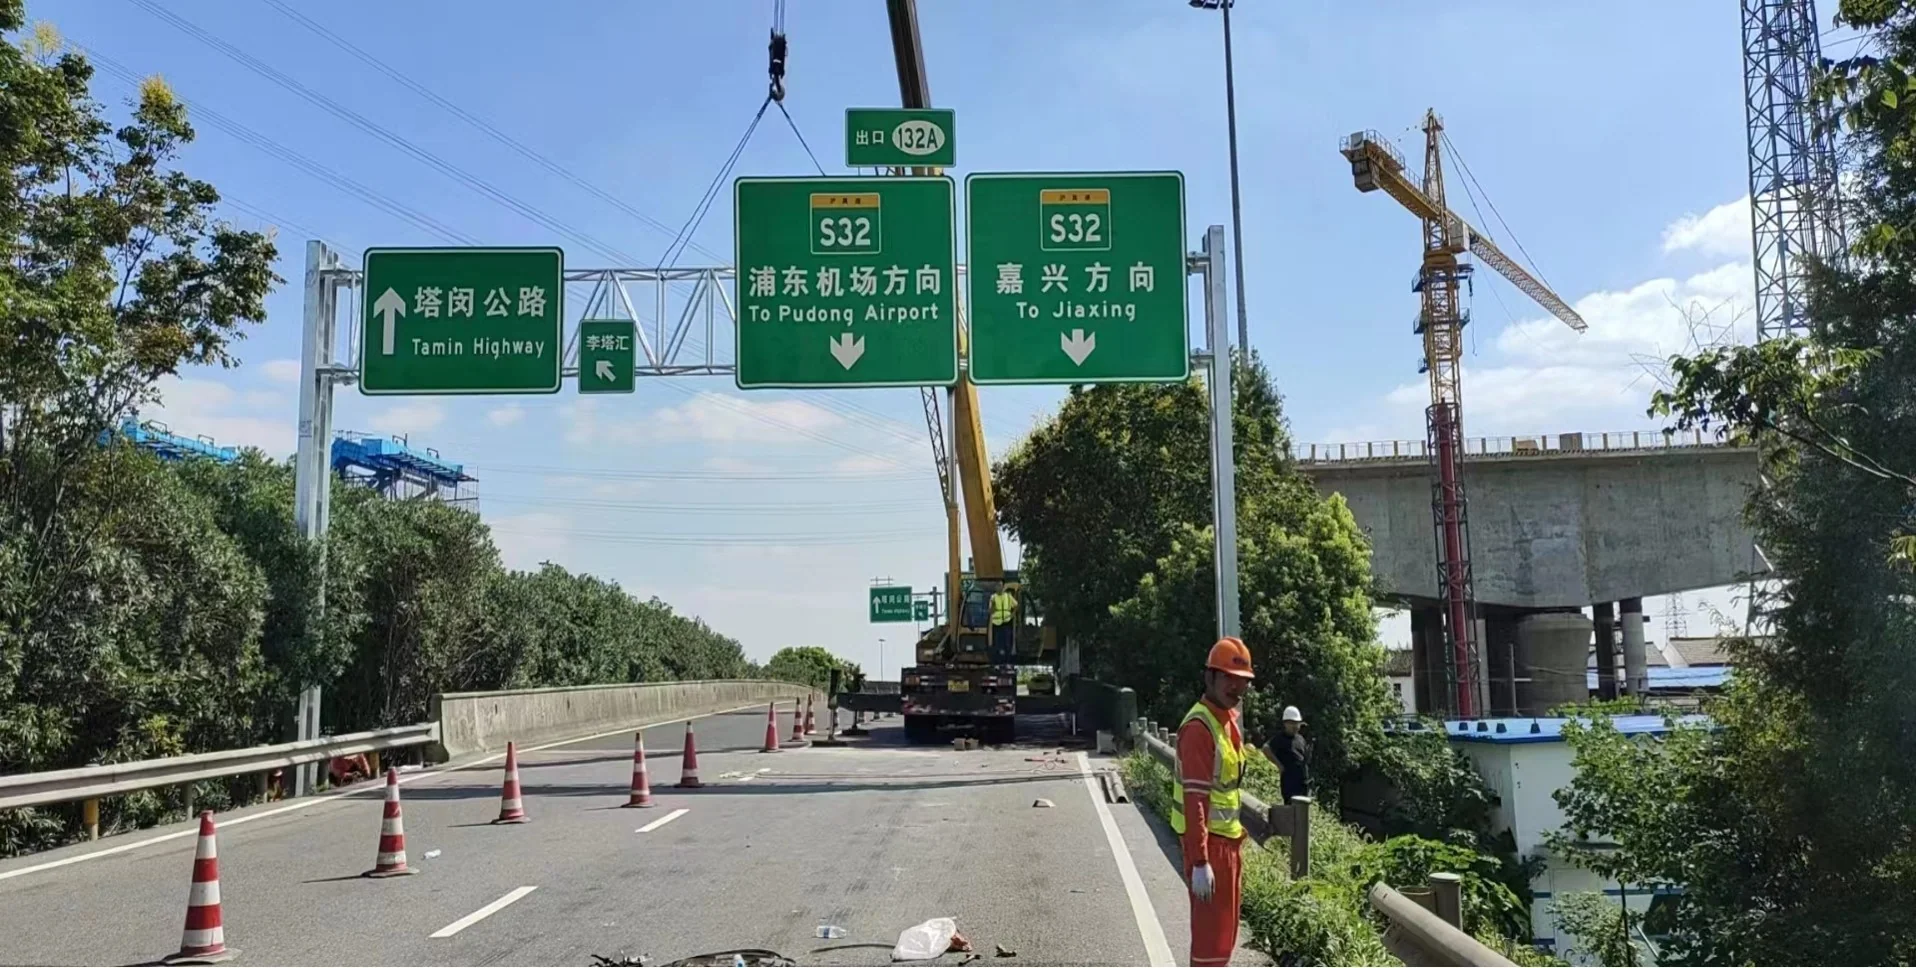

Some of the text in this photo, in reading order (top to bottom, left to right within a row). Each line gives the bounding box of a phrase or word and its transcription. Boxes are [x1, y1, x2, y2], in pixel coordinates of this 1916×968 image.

[856, 127, 939, 150] 出口 132A
[820, 217, 871, 246] S32
[1050, 213, 1102, 243] S32
[748, 264, 942, 297] 浦东机场方向
[996, 261, 1155, 294] 嘉兴方向
[413, 286, 547, 318] 塔闵公路
[748, 303, 940, 327] To Pudong Airport
[1016, 300, 1137, 322] To Jiaxing
[412, 337, 545, 360] Tamin Highway
[586, 334, 630, 351] 李塔汇
